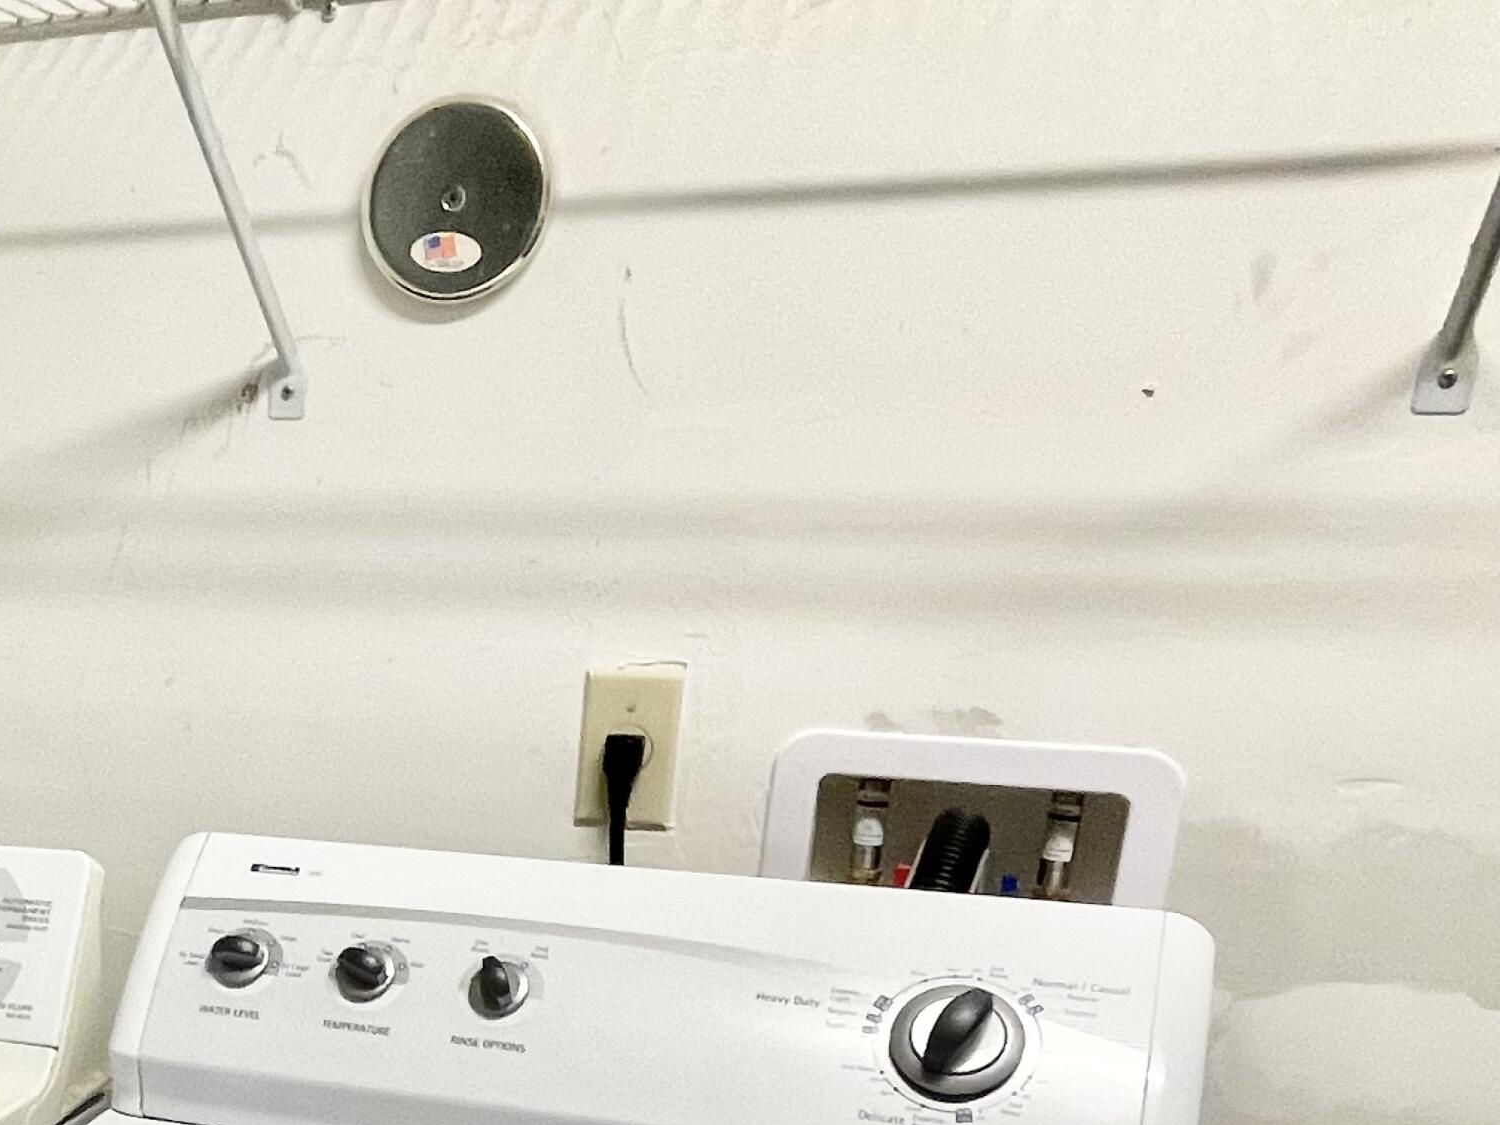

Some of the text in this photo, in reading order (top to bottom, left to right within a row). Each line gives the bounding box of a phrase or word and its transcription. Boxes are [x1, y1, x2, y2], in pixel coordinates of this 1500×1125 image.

[198, 1004, 260, 1020] WATER LEVEL
[322, 1019, 391, 1037] TEMPERATURE
[450, 1035, 527, 1053] RINSE OPTIONS
[857, 1108, 905, 1125] Delicate
